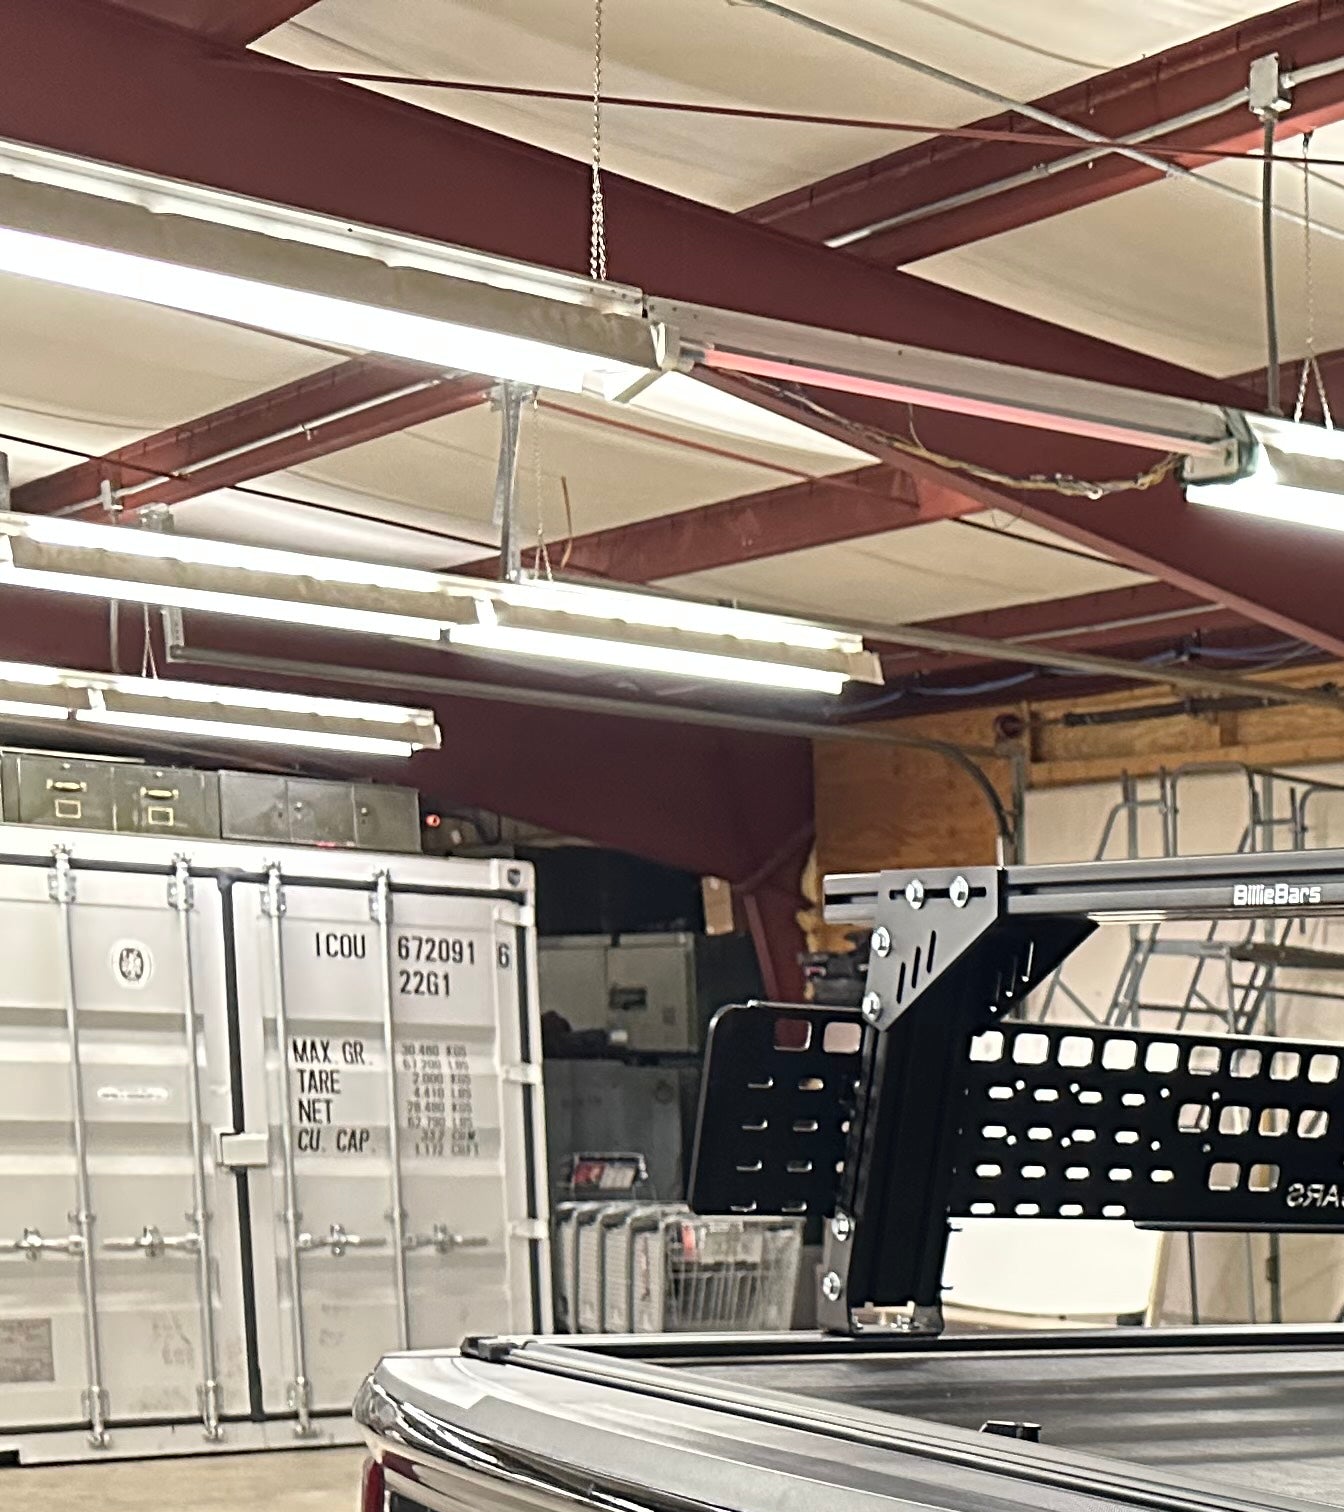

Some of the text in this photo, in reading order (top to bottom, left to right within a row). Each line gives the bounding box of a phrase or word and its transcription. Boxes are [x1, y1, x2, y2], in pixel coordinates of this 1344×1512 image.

[1233, 883, 1321, 906] BillieBars
[316, 932, 510, 969] ICOU 672091 6
[399, 970, 451, 997] 22G1
[297, 1069, 341, 1094] TARE
[298, 1098, 333, 1124] NET
